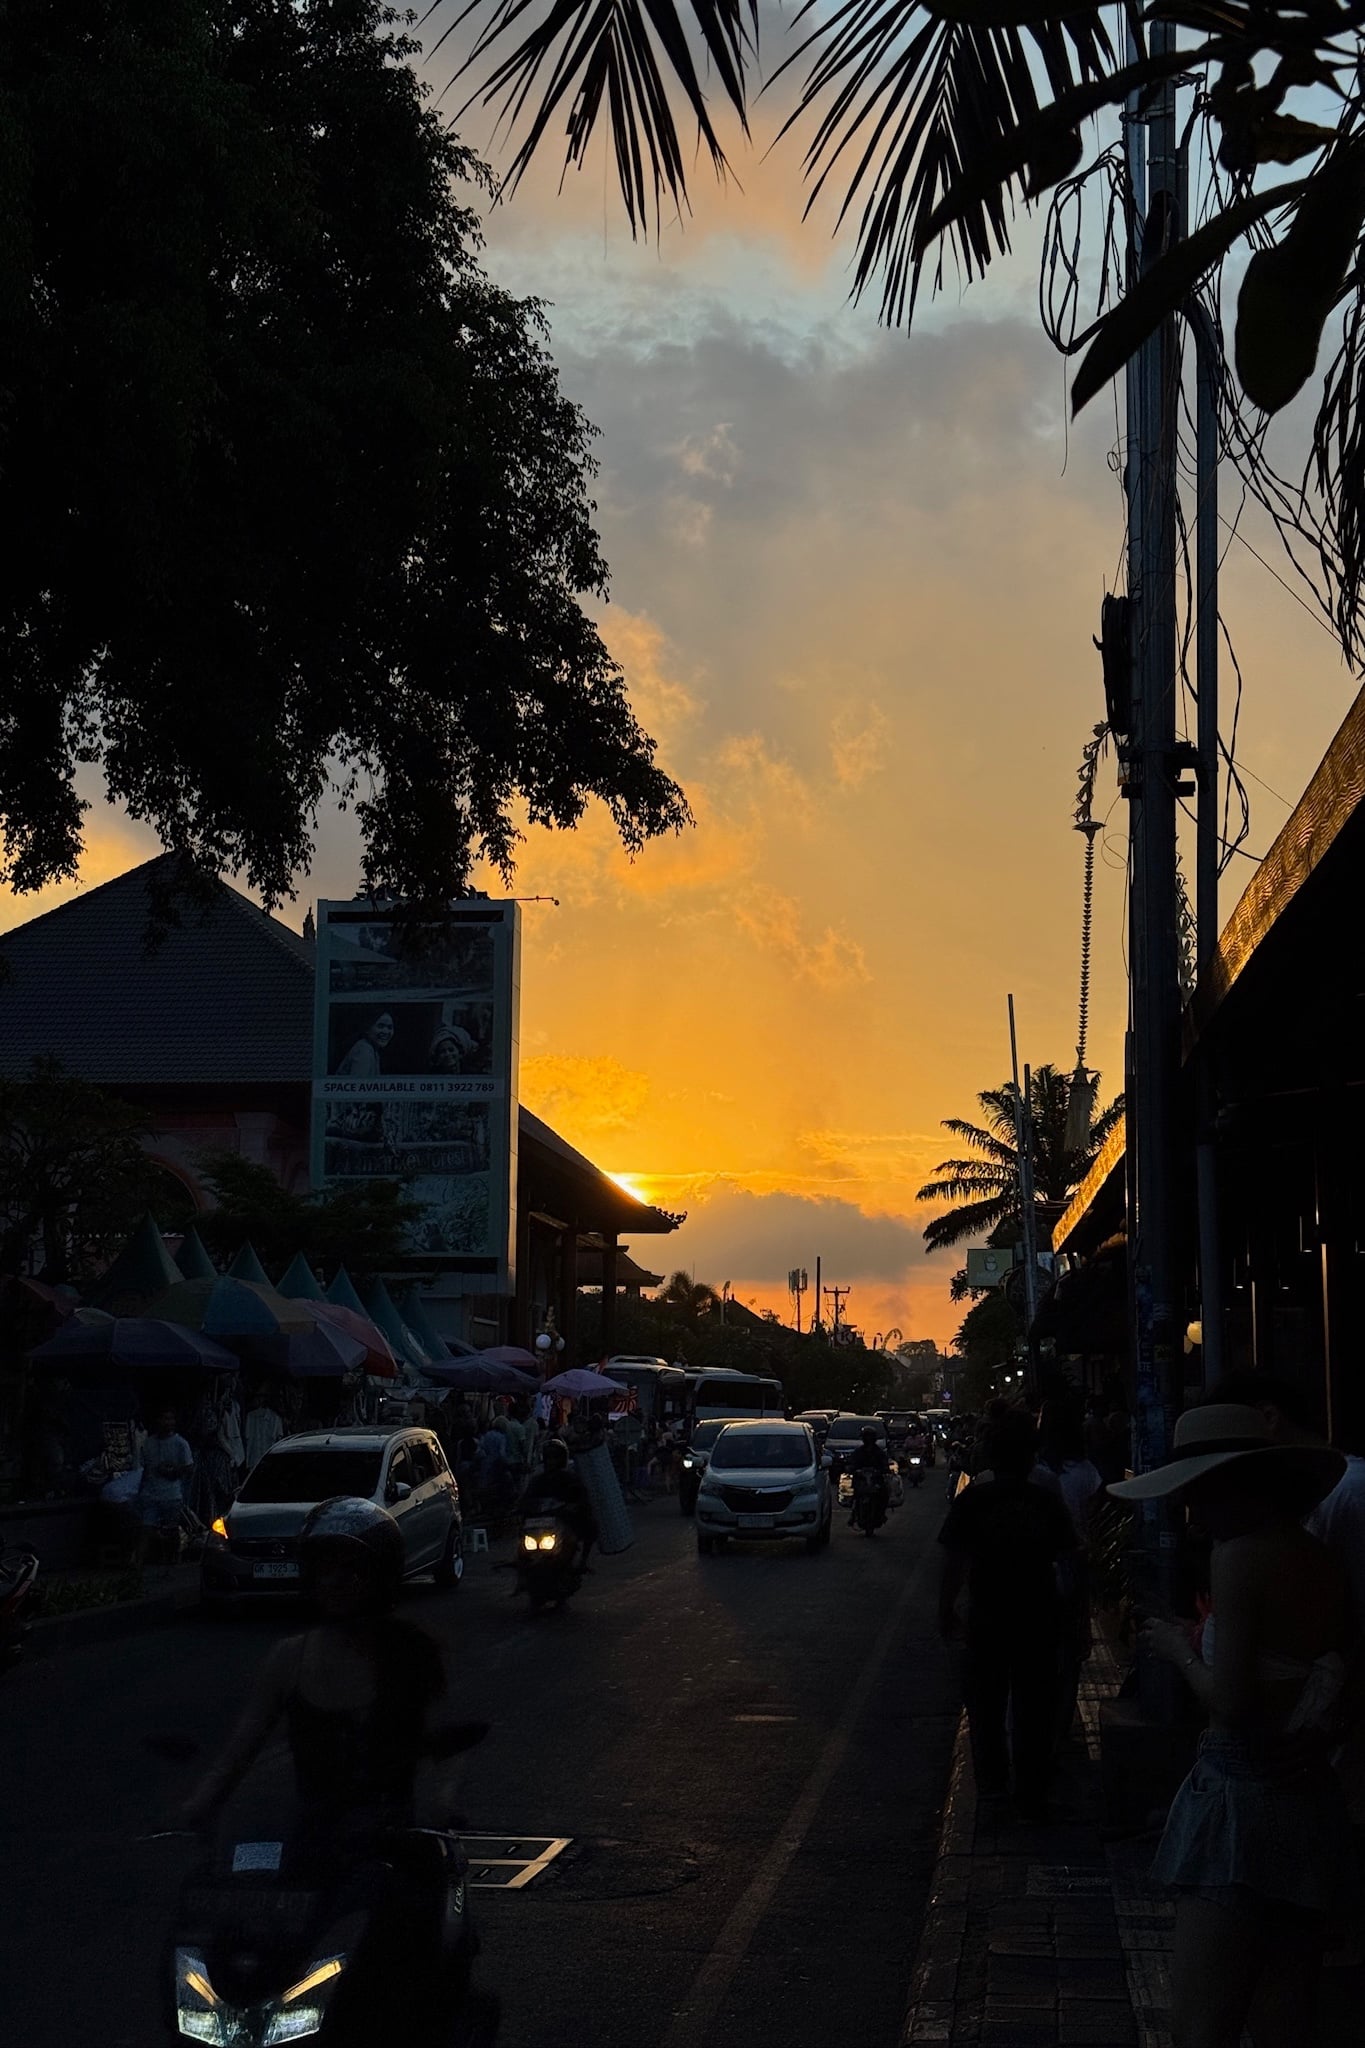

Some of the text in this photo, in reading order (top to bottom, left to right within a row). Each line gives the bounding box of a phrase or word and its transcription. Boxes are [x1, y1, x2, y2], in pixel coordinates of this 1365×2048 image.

[323, 1082, 495, 1092] SPACE AVAILABLE 0811 3922 789
